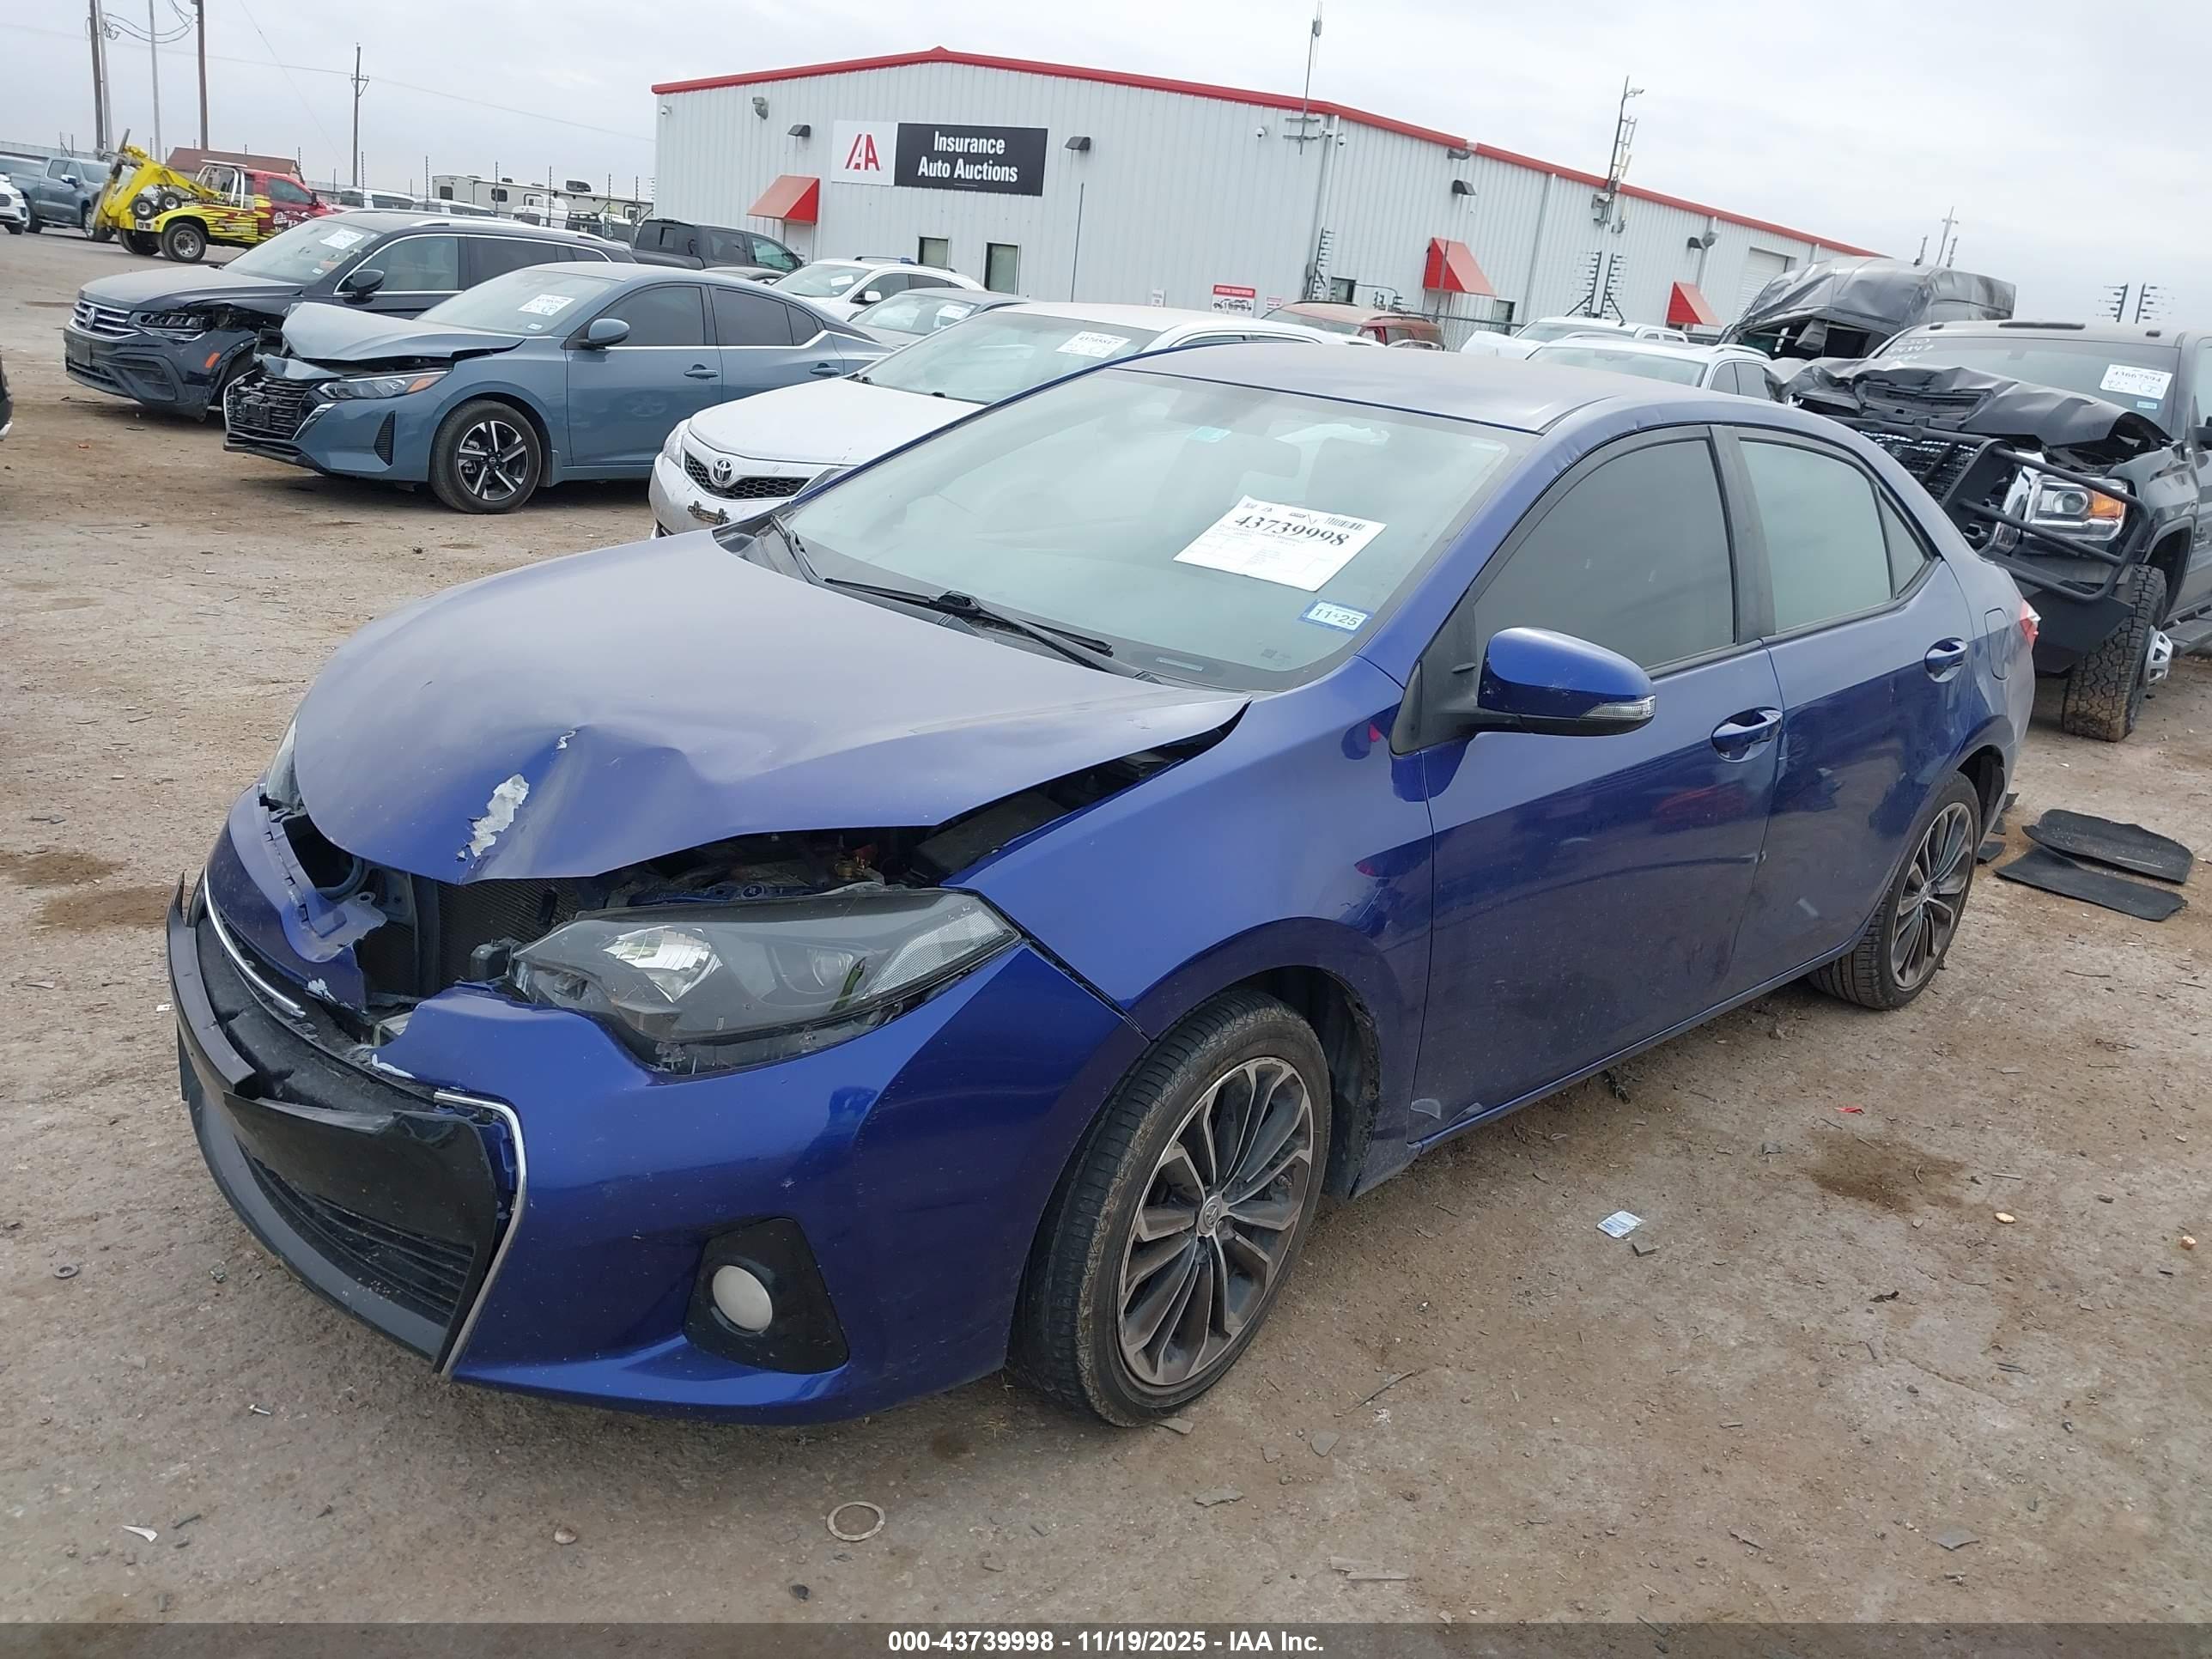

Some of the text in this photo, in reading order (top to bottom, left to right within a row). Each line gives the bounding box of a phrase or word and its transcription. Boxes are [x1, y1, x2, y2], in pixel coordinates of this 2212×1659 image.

[933, 131, 1006, 155] Insurance
[917, 156, 1018, 183] Auto Auctions
[1234, 514, 1350, 546] 43739998
